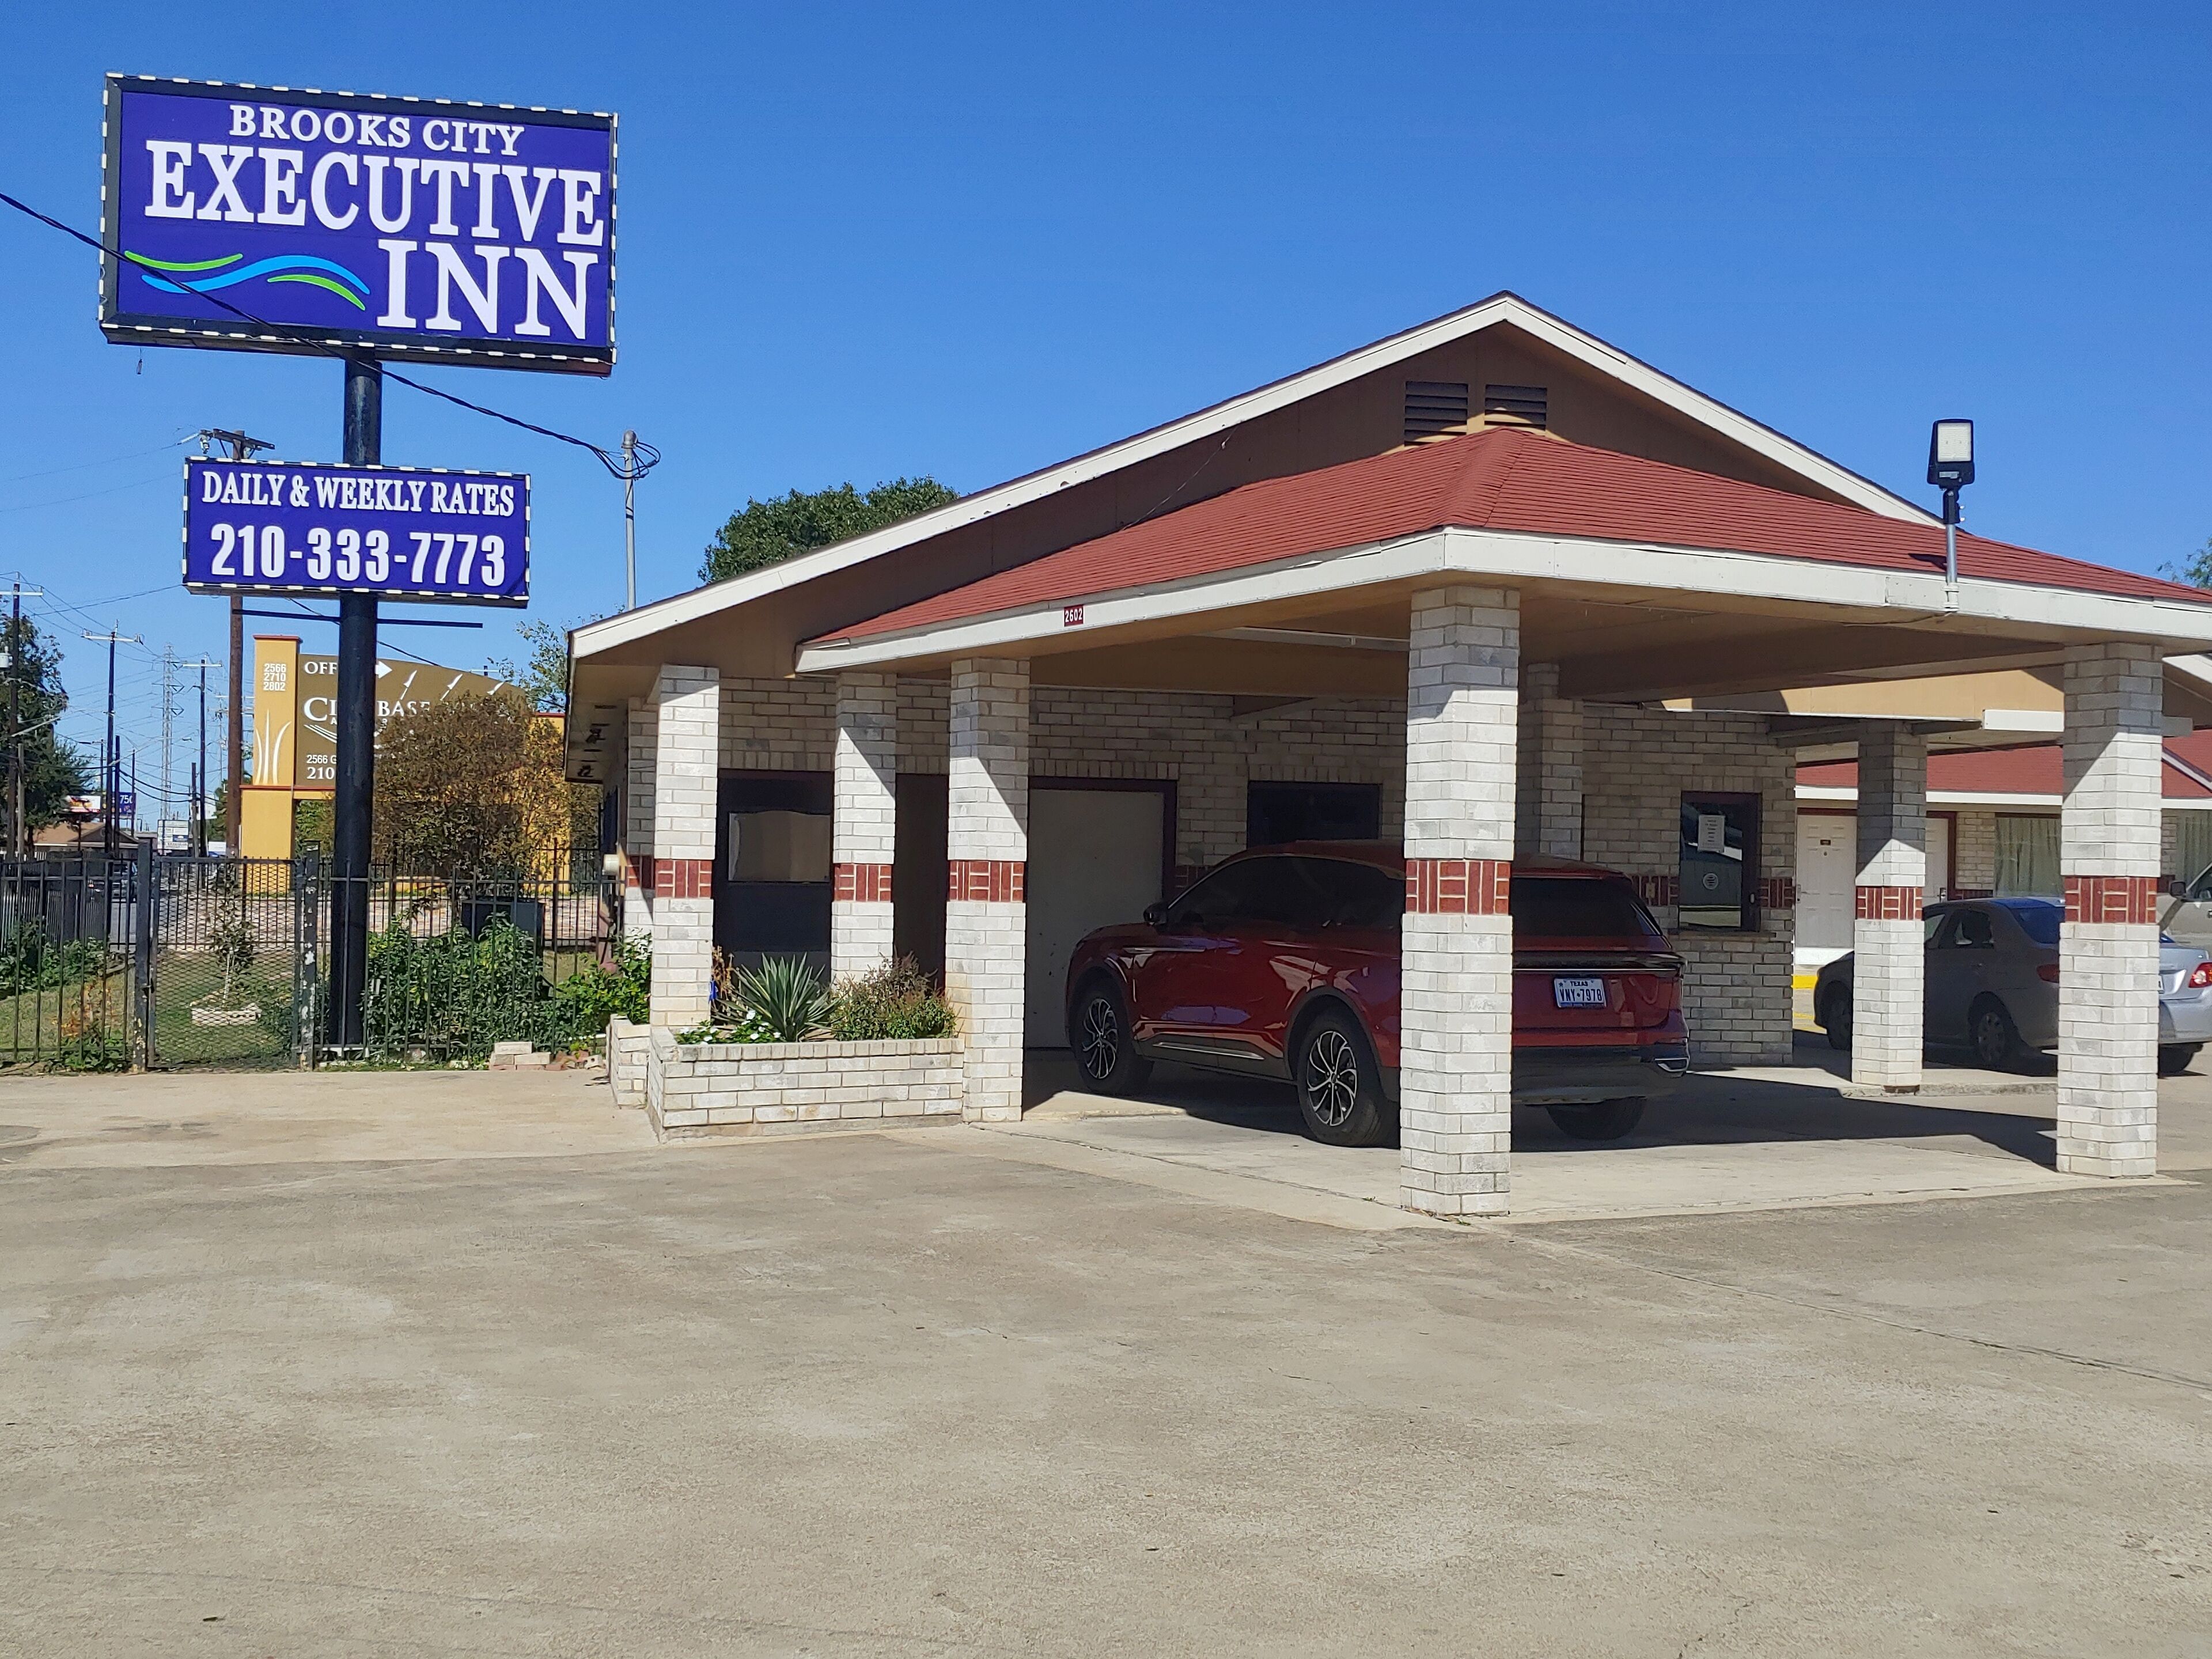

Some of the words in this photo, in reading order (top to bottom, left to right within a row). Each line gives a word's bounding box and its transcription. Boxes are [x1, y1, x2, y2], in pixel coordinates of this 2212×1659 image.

[229, 105, 411, 147] BROOKS
[423, 119, 525, 156] CITY
[145, 140, 604, 247] EXECUTIVE
[377, 239, 599, 339] INN
[202, 471, 286, 506] DAILY
[290, 475, 309, 507] &
[315, 476, 426, 512] WEEKLY
[431, 482, 514, 517] RATES
[211, 523, 505, 587] 210-333-7773
[1065, 608, 1083, 622] 2602
[263, 663, 286, 673] 2566
[304, 662, 338, 675] OFF
[263, 672, 286, 682] 2710
[263, 681, 286, 691] 2802
[306, 755, 328, 764] 2566
